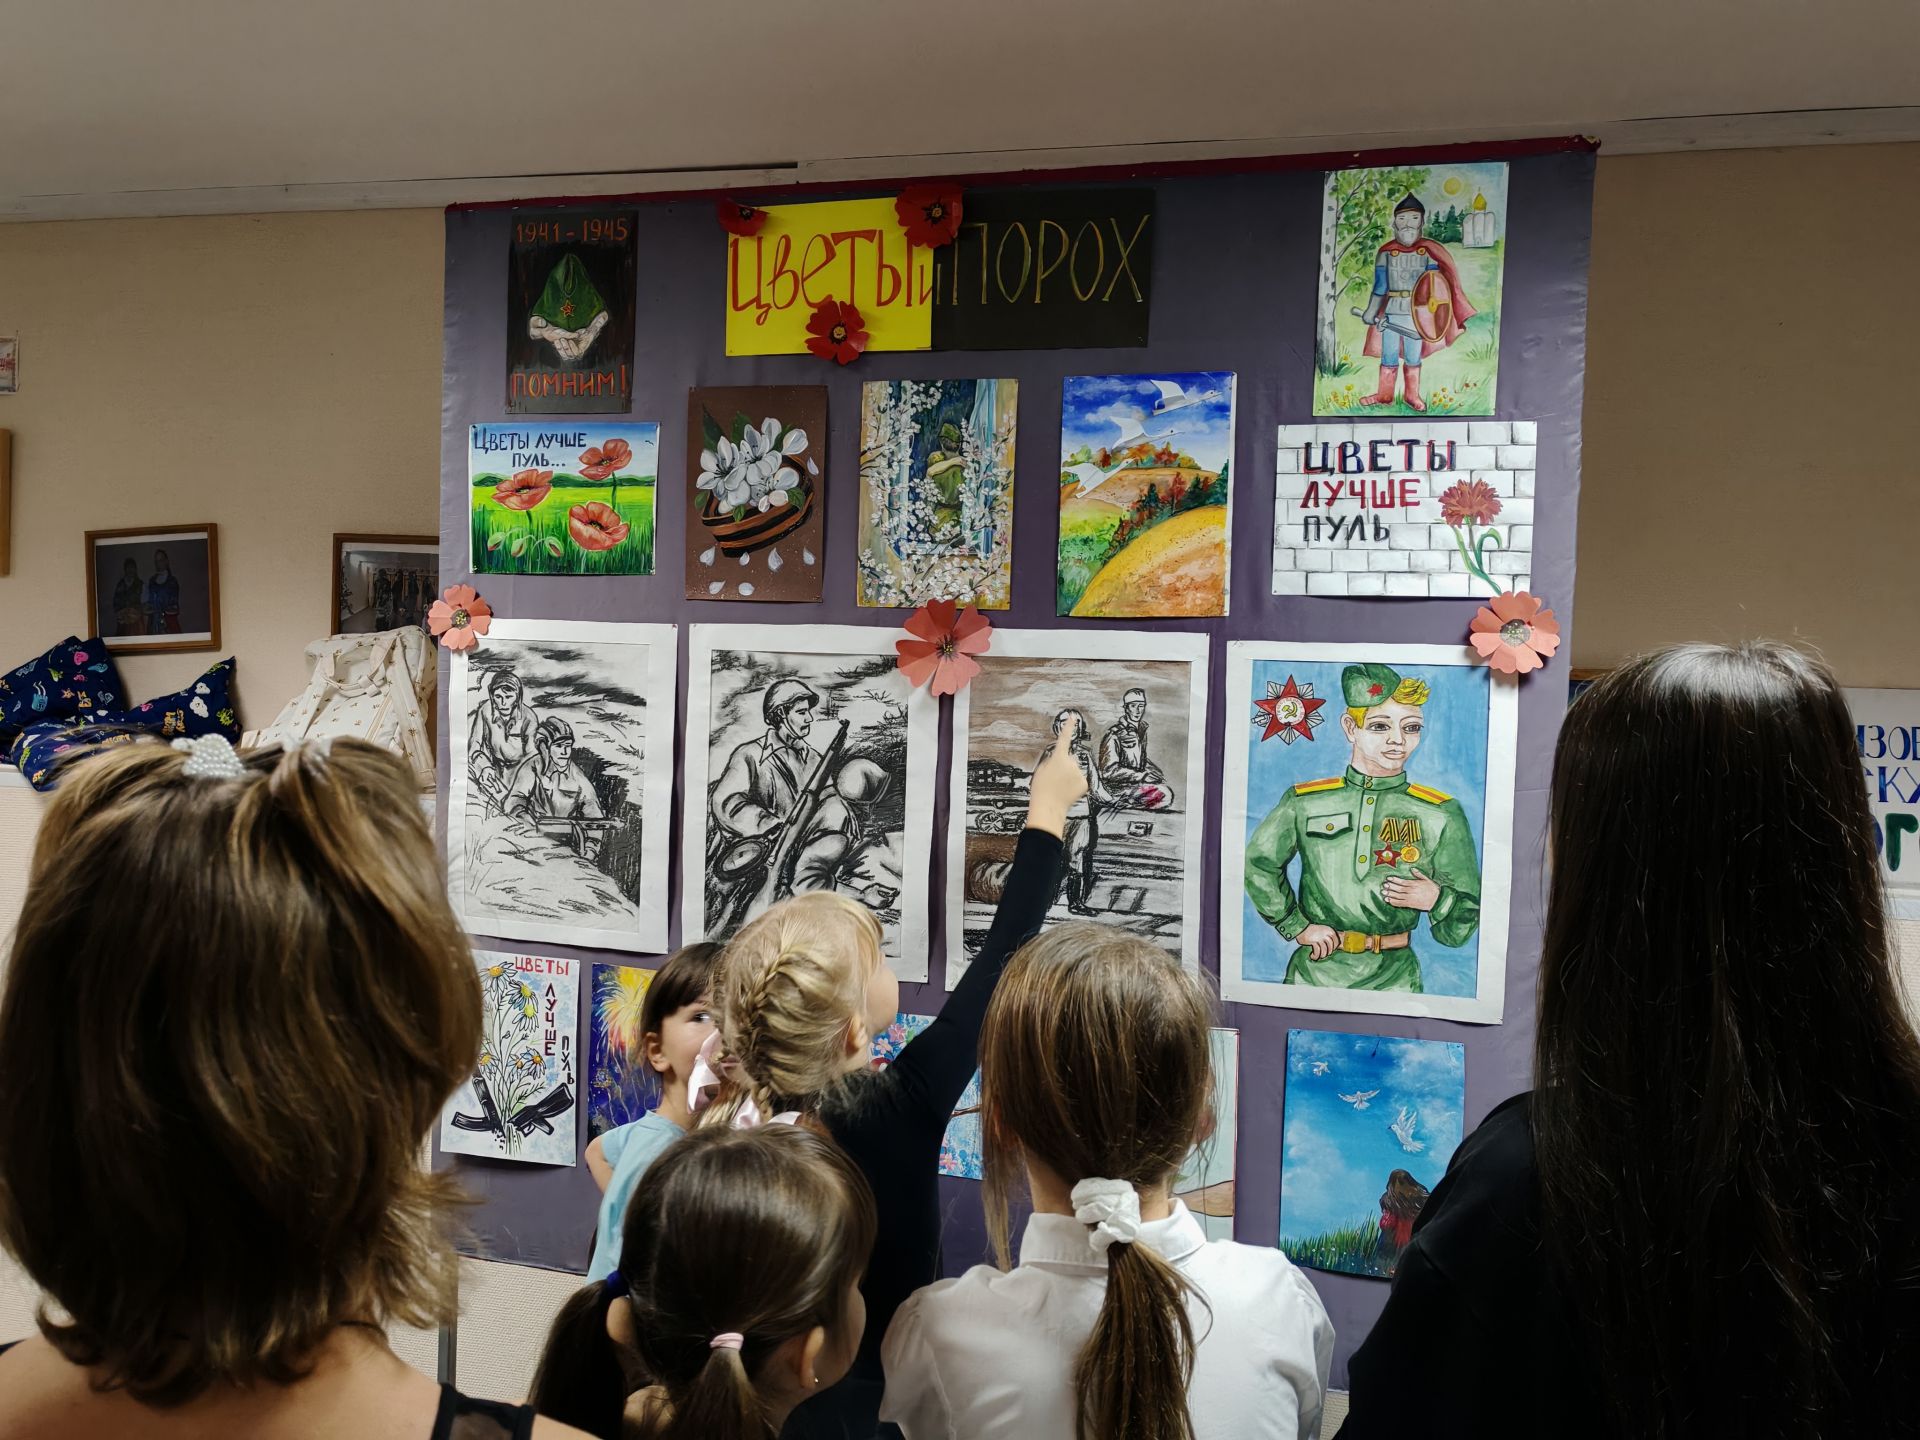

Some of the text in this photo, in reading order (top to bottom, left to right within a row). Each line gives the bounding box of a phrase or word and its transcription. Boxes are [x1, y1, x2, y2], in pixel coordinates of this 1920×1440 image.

[516, 222, 560, 243] 1941
[582, 217, 629, 242] 1945
[951, 214, 1151, 306] ПОРОХ
[511, 364, 627, 399] ПОМНИМ!
[534, 432, 588, 449] ЛУЧШЕ
[511, 452, 567, 468] ПУЛЬ...
[1303, 439, 1457, 476] ЦВЕТЫ
[1300, 478, 1422, 509] ЛУЧШЕ
[1303, 513, 1391, 542] ПУЛЬ
[515, 956, 570, 976] ЦВЕТЫ
[544, 982, 558, 1056] ЛУЧШЕ
[561, 1035, 575, 1085] ПУЛЬ
